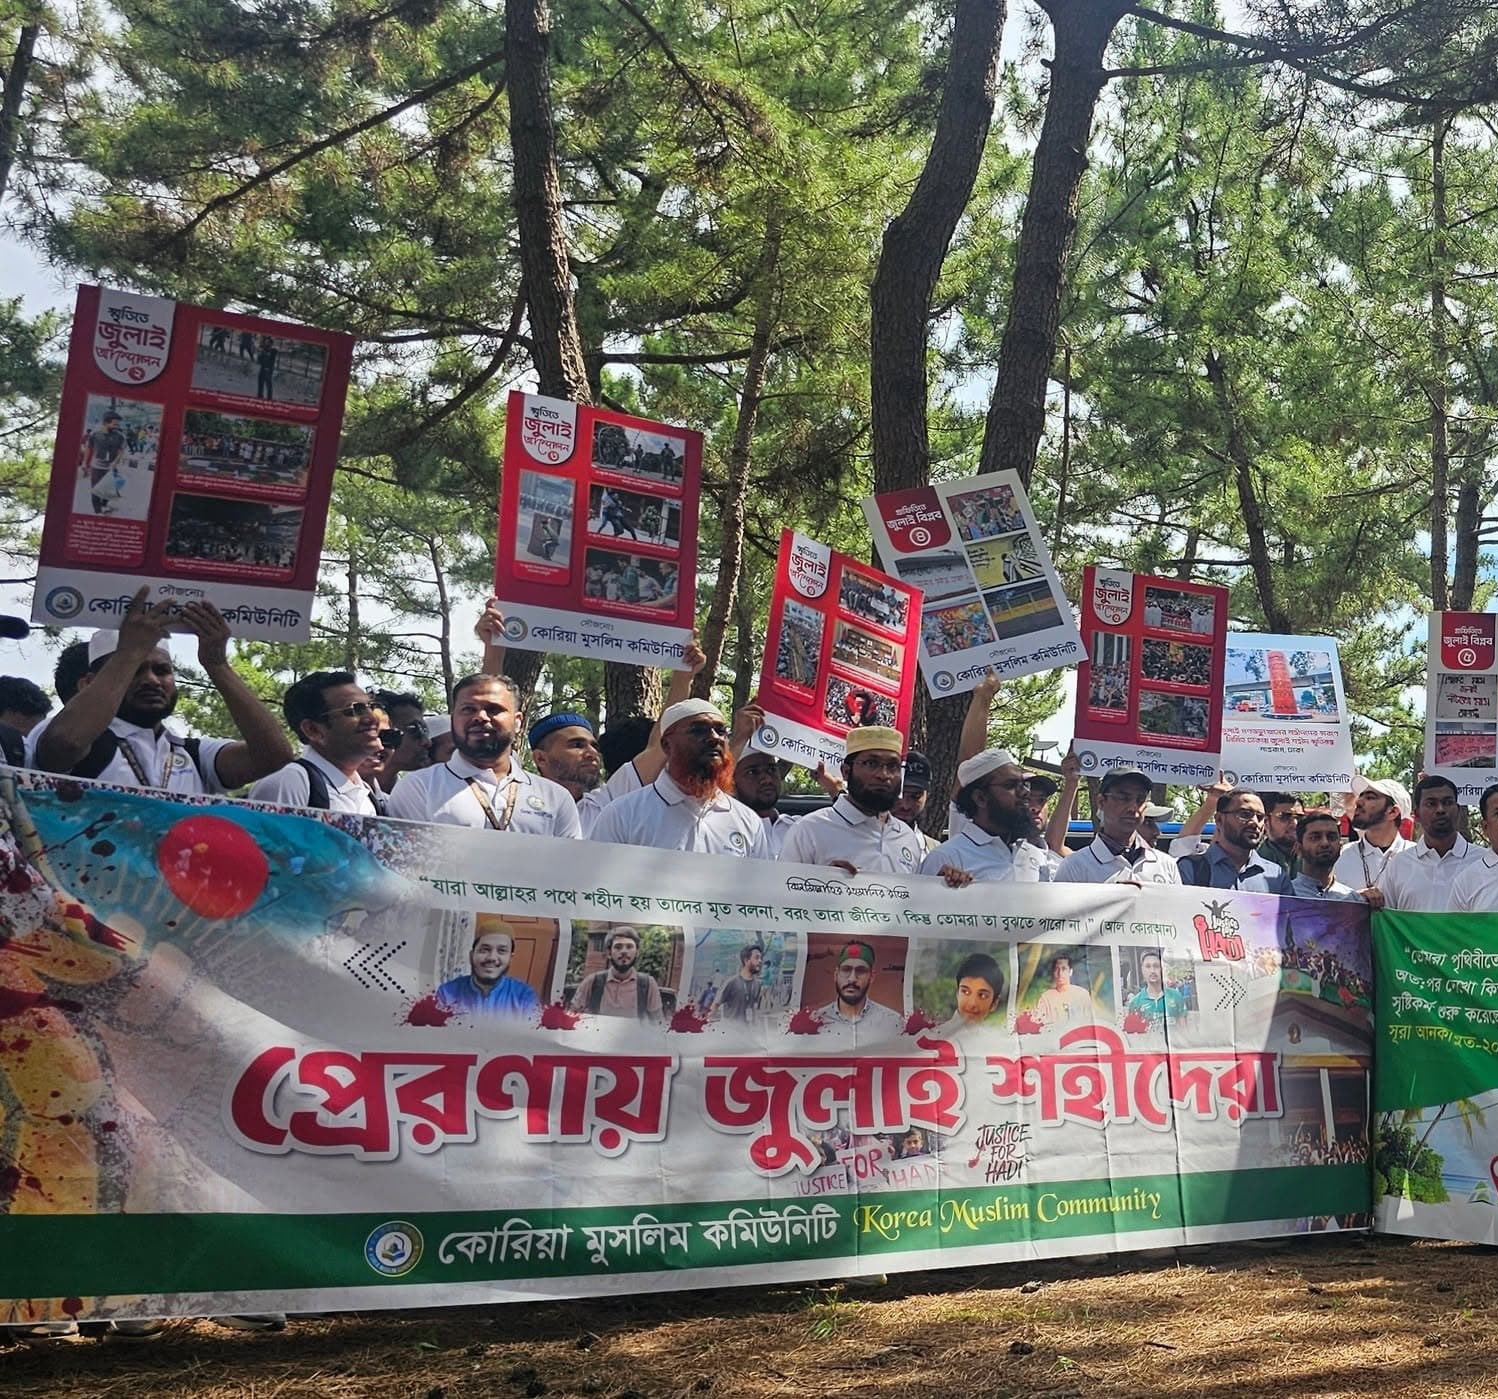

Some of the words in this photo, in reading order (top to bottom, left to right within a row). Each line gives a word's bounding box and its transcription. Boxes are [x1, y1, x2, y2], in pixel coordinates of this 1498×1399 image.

[98, 321, 167, 350] জুলাই
[525, 417, 572, 439] জুলাই
[886, 514, 917, 532] জুলাই
[915, 510, 942, 523] বিপ্লব
[792, 553, 827, 578] জুলাই
[1095, 587, 1130, 604] জুলাই
[220, 605, 301, 629] কমিউনিটি
[531, 626, 578, 643] কোরিয়া
[581, 632, 623, 648] মুসলিম
[627, 638, 685, 658] কমিউনিটি
[1443, 635, 1469, 648] জুলাই
[1470, 635, 1493, 646] বিপ্লব
[956, 664, 992, 681] কোরিয়া
[993, 655, 1029, 673] মুসলিম
[1030, 641, 1077, 661] কমিউনিটি
[781, 737, 816, 758] কোরিয়া
[818, 750, 847, 768] মুসলি
[1137, 760, 1168, 774] মুসলিম
[1170, 762, 1215, 778] কমিউনিটি
[1240, 772, 1273, 784] কোরিয়া
[1275, 772, 1305, 785] মুসলিম
[1308, 773, 1351, 785] কমিউনিটি
[472, 882, 537, 904] আল্লাহর
[543, 887, 577, 906] পথে
[582, 887, 623, 911] শহীদ
[628, 895, 652, 912] হয়
[656, 898, 702, 915] তাদের
[707, 901, 731, 921] মৃত
[736, 903, 779, 922] বলনা,
[783, 906, 810, 922] বরং
[814, 907, 845, 923] তারা
[849, 906, 890, 924] জীবিত
[903, 909, 932, 926] কিন্তু
[936, 913, 978, 928] তোমরা
[981, 914, 998, 928] তা
[1002, 915, 1034, 933] বুঝতে
[1038, 917, 1066, 932] পারো
[1099, 919, 1125, 937] (আল
[1129, 920, 1177, 940] কোরআন)
[1438, 1005, 1461, 1023] শুরু
[1389, 1024, 1412, 1044] সূরা
[229, 1046, 675, 1154] প্রেরণায়
[703, 1035, 962, 1172] জুলাই
[986, 1026, 1279, 1122] শহীদেরা
[976, 1123, 1033, 1148] JUSTICE
[842, 1149, 882, 1180] FOR
[990, 1144, 1022, 1161] FOR
[985, 1159, 1024, 1184] HADI
[438, 1217, 575, 1265] কোরিয়া
[580, 1212, 693, 1267] মুসলিম
[698, 1202, 841, 1251] কমিউনিটি
[853, 1204, 933, 1241] Korea
[940, 1195, 1030, 1233] Muslim
[1037, 1187, 1162, 1224] Community
